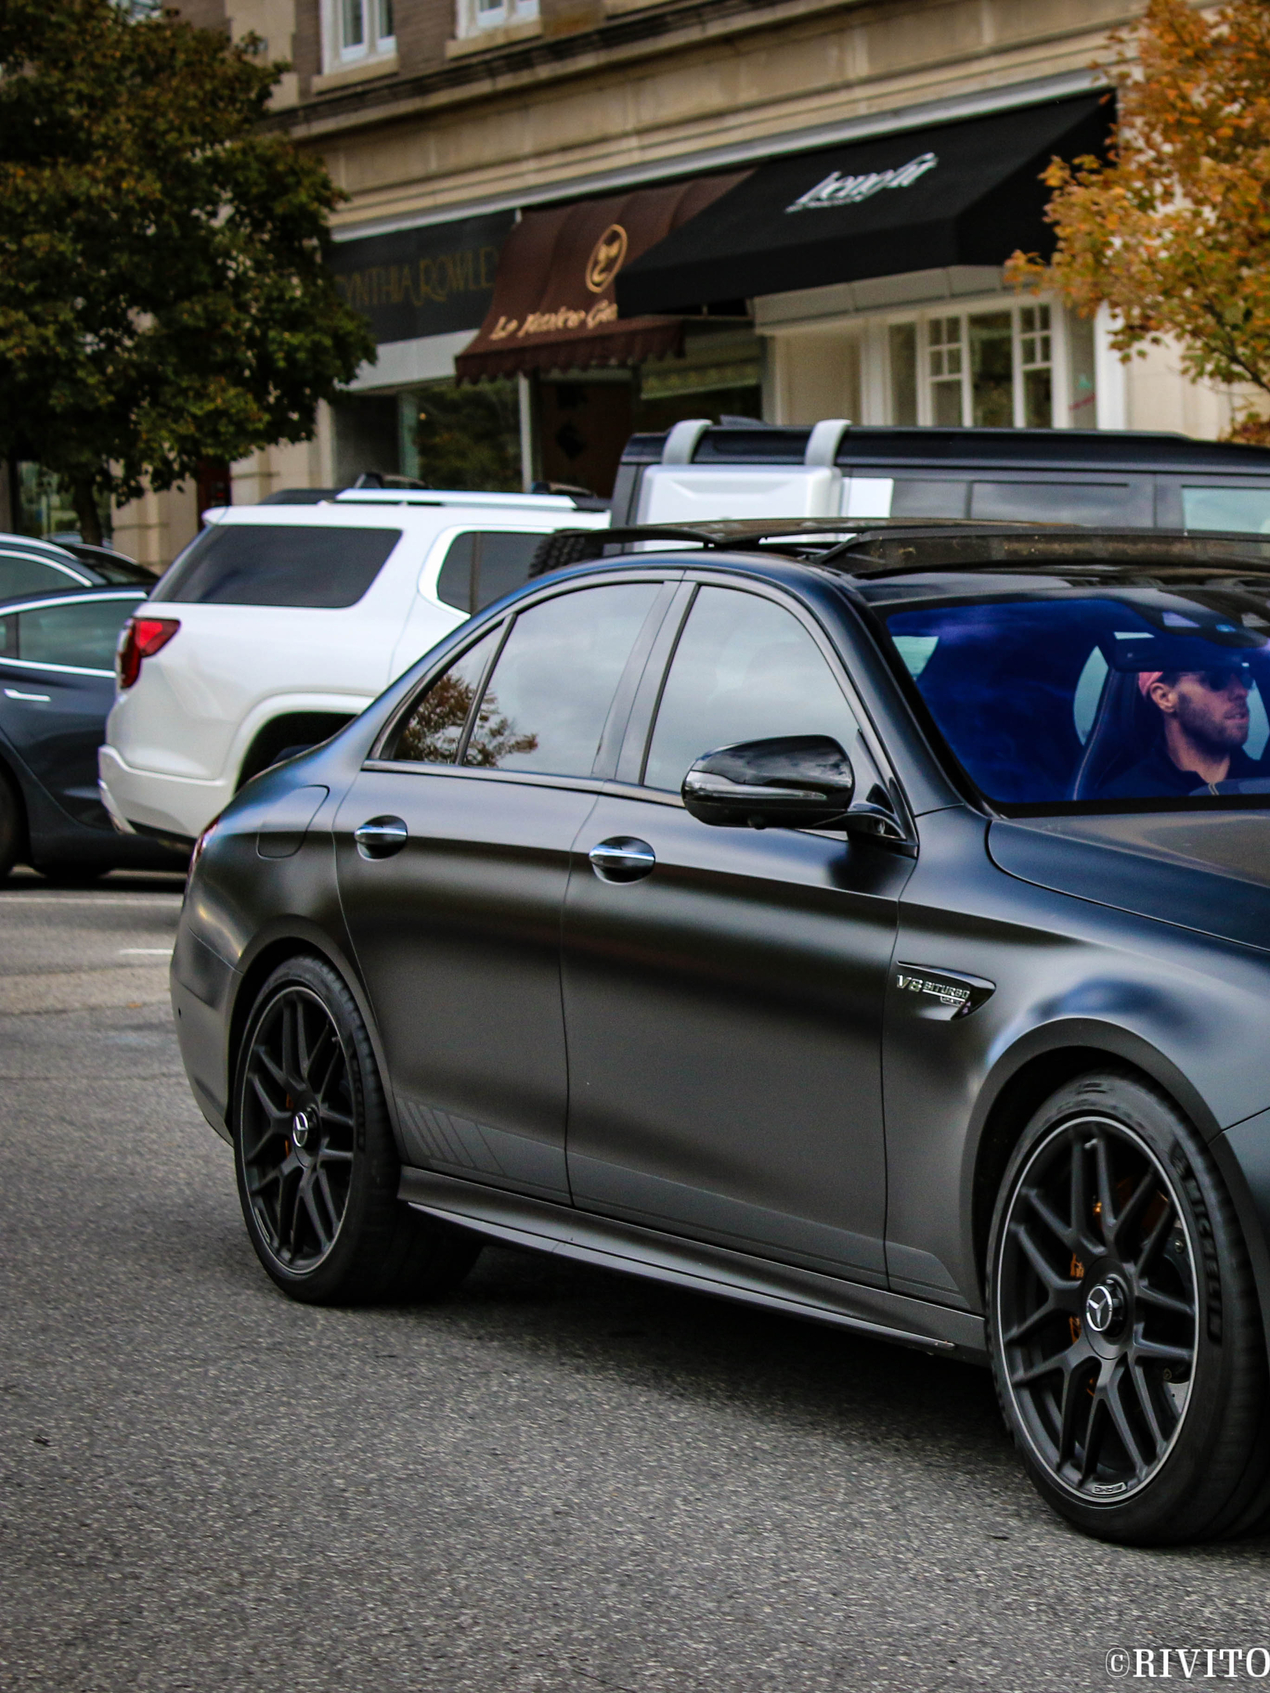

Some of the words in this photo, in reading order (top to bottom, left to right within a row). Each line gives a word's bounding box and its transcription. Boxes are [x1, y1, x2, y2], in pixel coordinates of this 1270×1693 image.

[419, 246, 498, 302] ROWLE
[896, 974, 923, 992] V8
[923, 981, 970, 998] BITURBO
